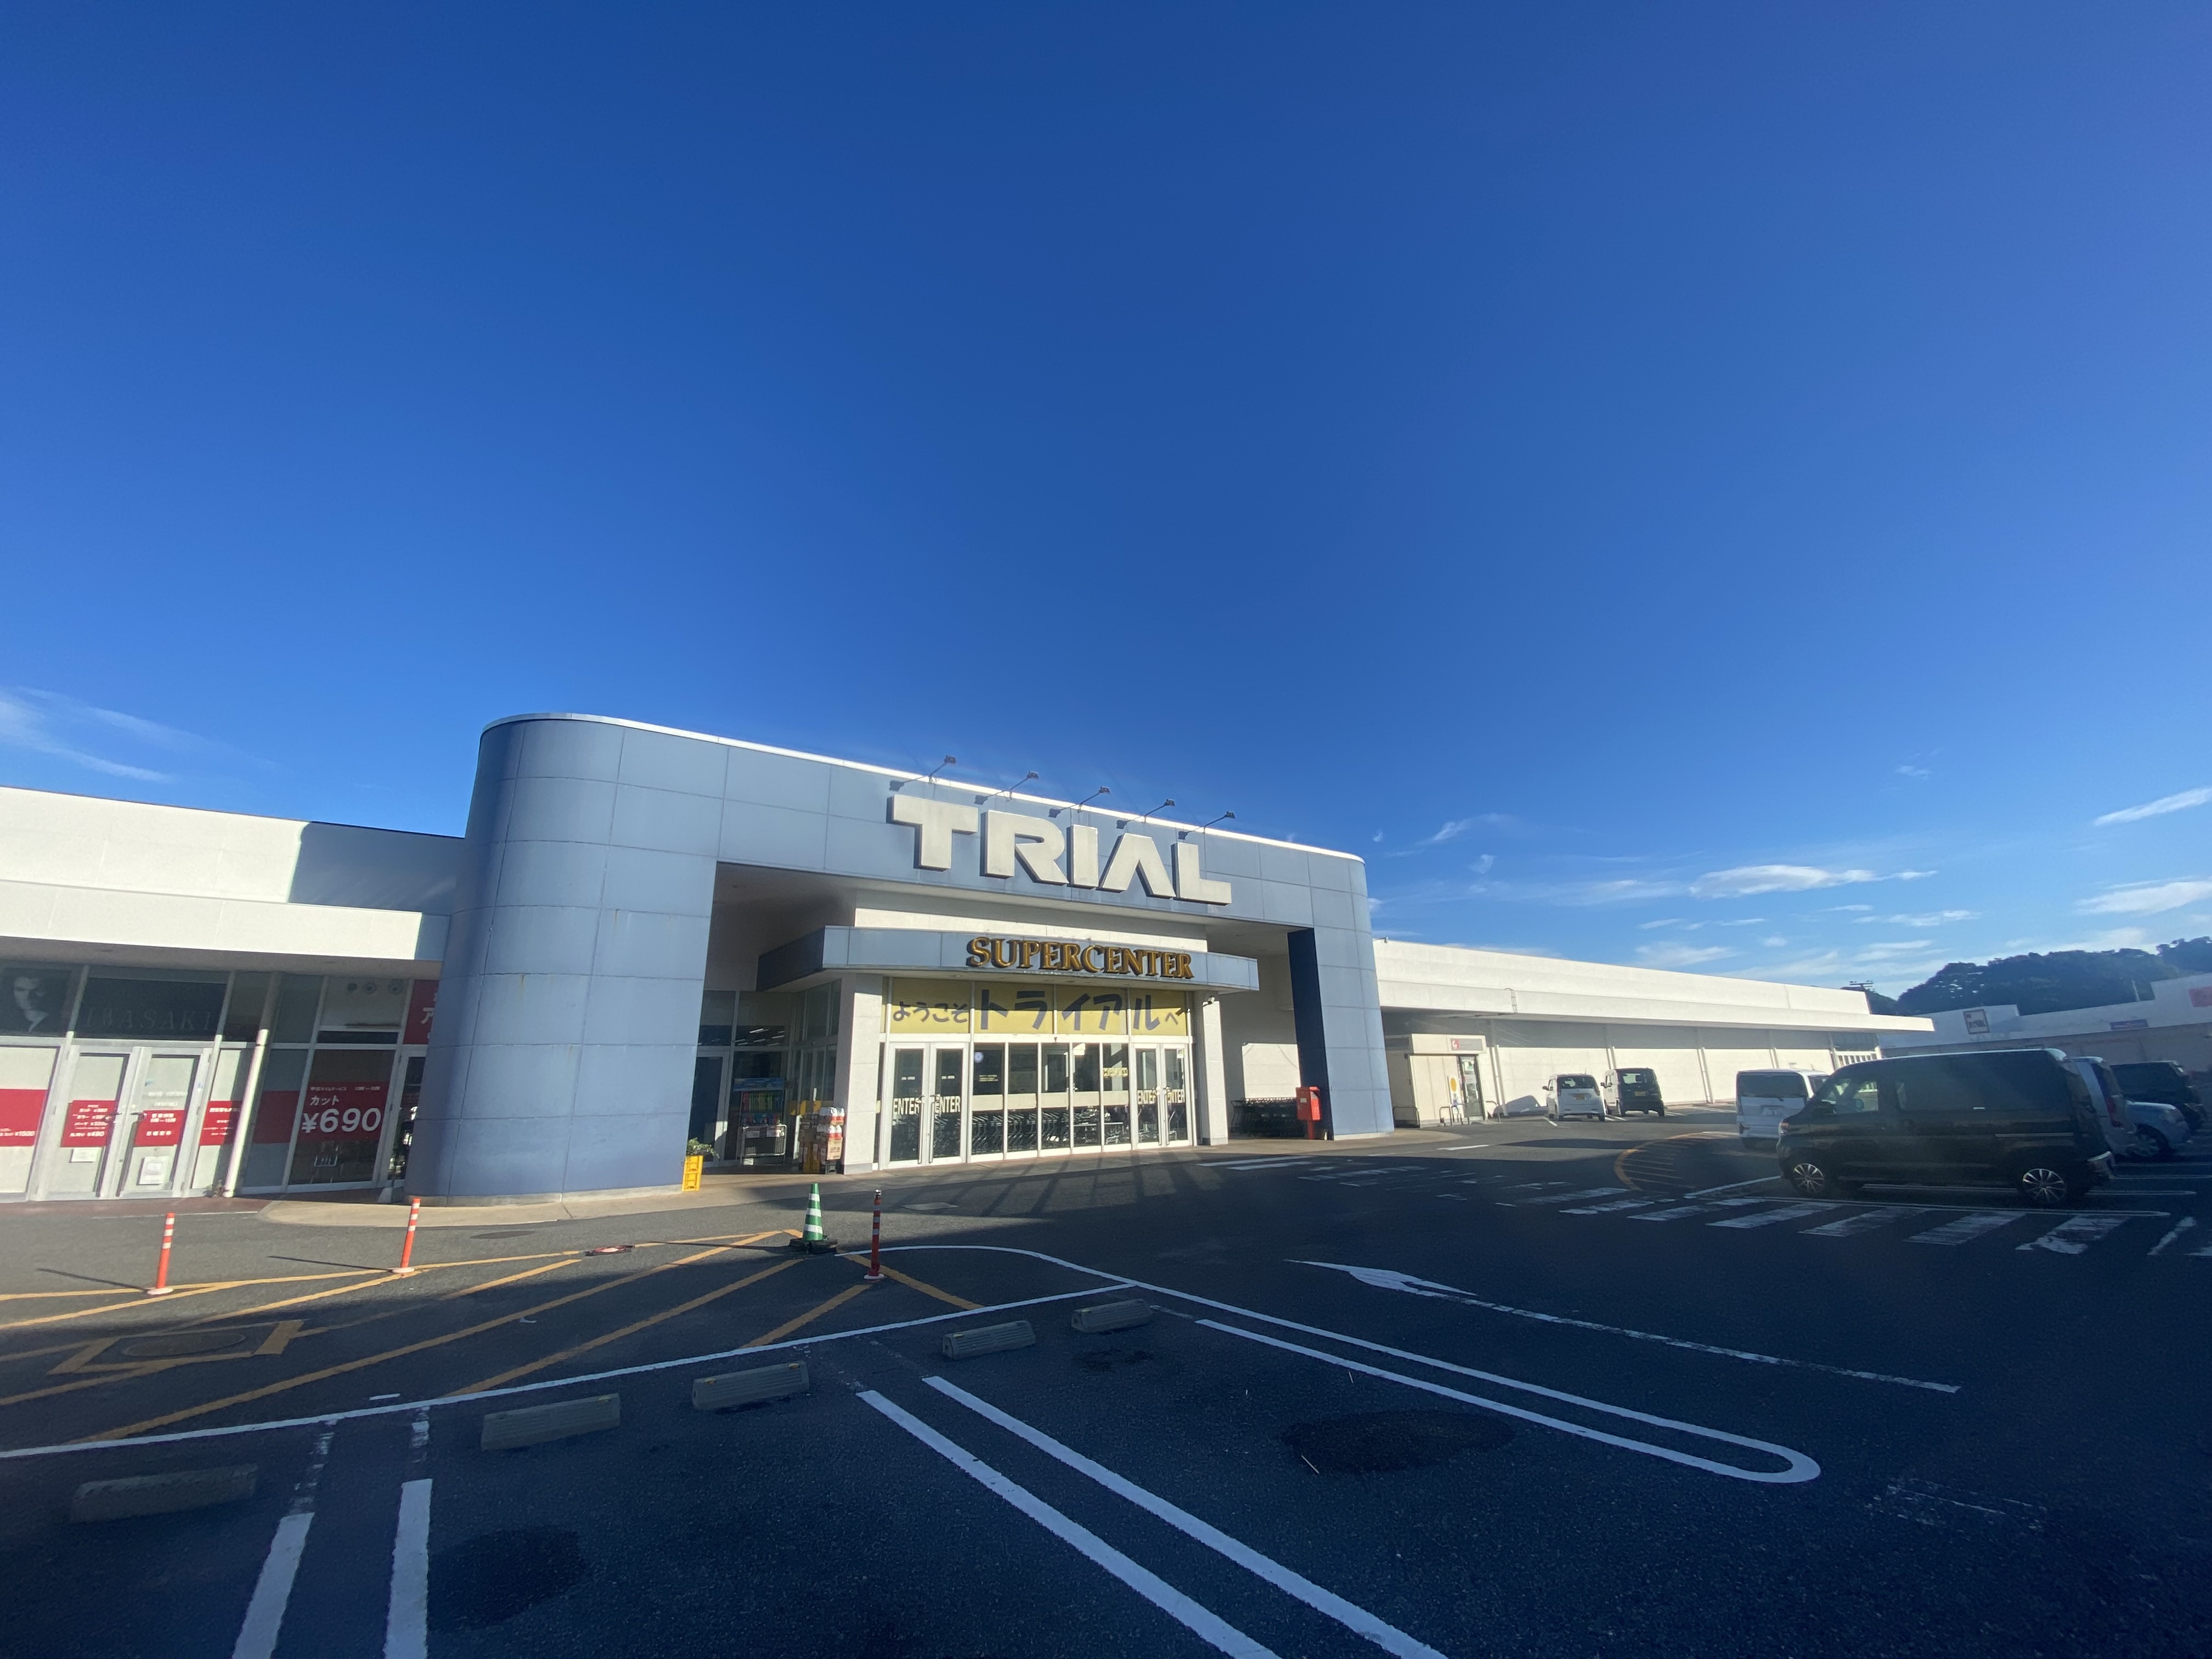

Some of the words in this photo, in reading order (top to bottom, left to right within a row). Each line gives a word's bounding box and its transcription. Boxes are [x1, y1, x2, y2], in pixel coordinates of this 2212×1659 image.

[887, 794, 1232, 905] TRIAL
[966, 936, 1194, 979] SUPERCENTER
[310, 1095, 339, 1105] カット
[893, 1098, 919, 1115] ENTER
[302, 1108, 381, 1133] ¥690
